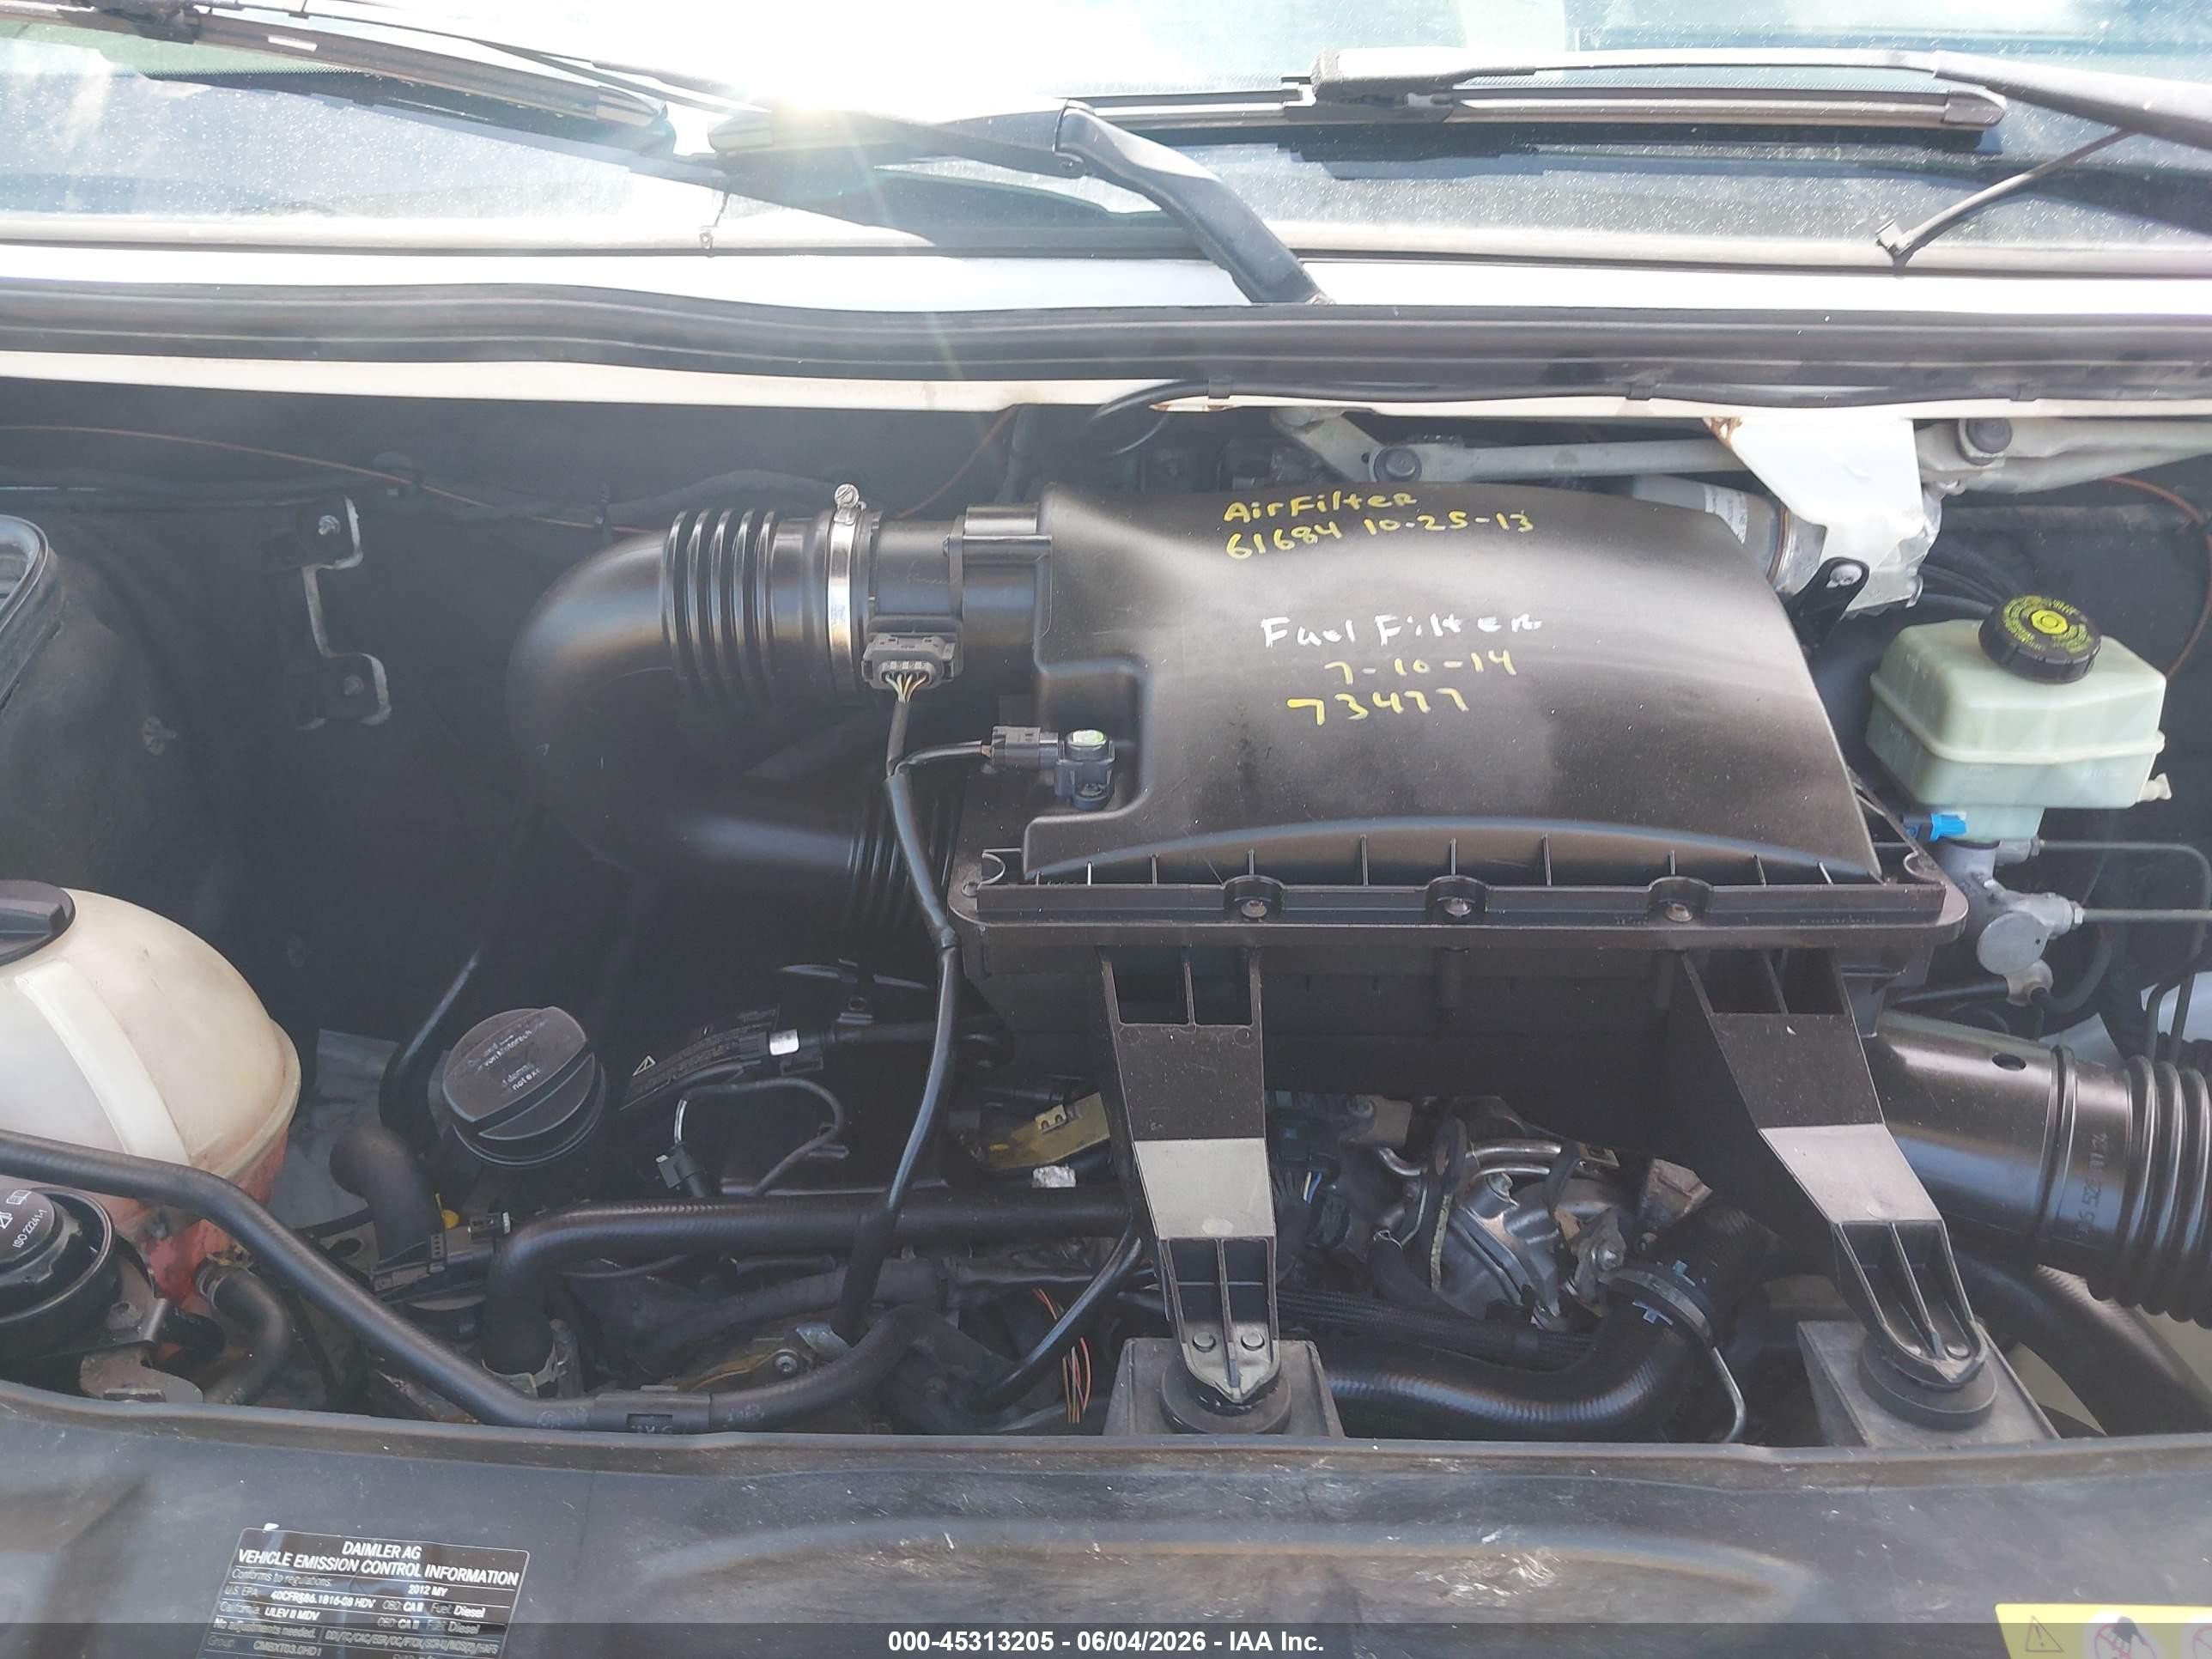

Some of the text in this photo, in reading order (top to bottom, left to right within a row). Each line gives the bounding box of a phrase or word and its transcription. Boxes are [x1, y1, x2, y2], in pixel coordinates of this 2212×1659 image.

[1226, 510, 1534, 560] 61684 10-25-13
[1261, 617, 1355, 648] Fuel
[1286, 688, 1469, 726] 73477
[12, 1233, 27, 1248] ISO
[342, 1541, 422, 1559] DAIMLER AG
[238, 1549, 520, 1586] VEHICLE EMISSION CONTROL INFORMATION
[231, 1568, 273, 1583] Conforms
[274, 1572, 283, 1583] to
[408, 1584, 429, 1595] 2012
[431, 1587, 448, 1597] MY
[264, 1607, 287, 1617] ULEV
[297, 1611, 320, 1620] MDV
[398, 1619, 411, 1629] CA
[447, 1621, 480, 1634] Diesel
[354, 1597, 376, 1608] HDV
[403, 1601, 416, 1612] CA
[453, 1606, 486, 1618] Diesel
[213, 1618, 316, 1638] No adjustments needed.
